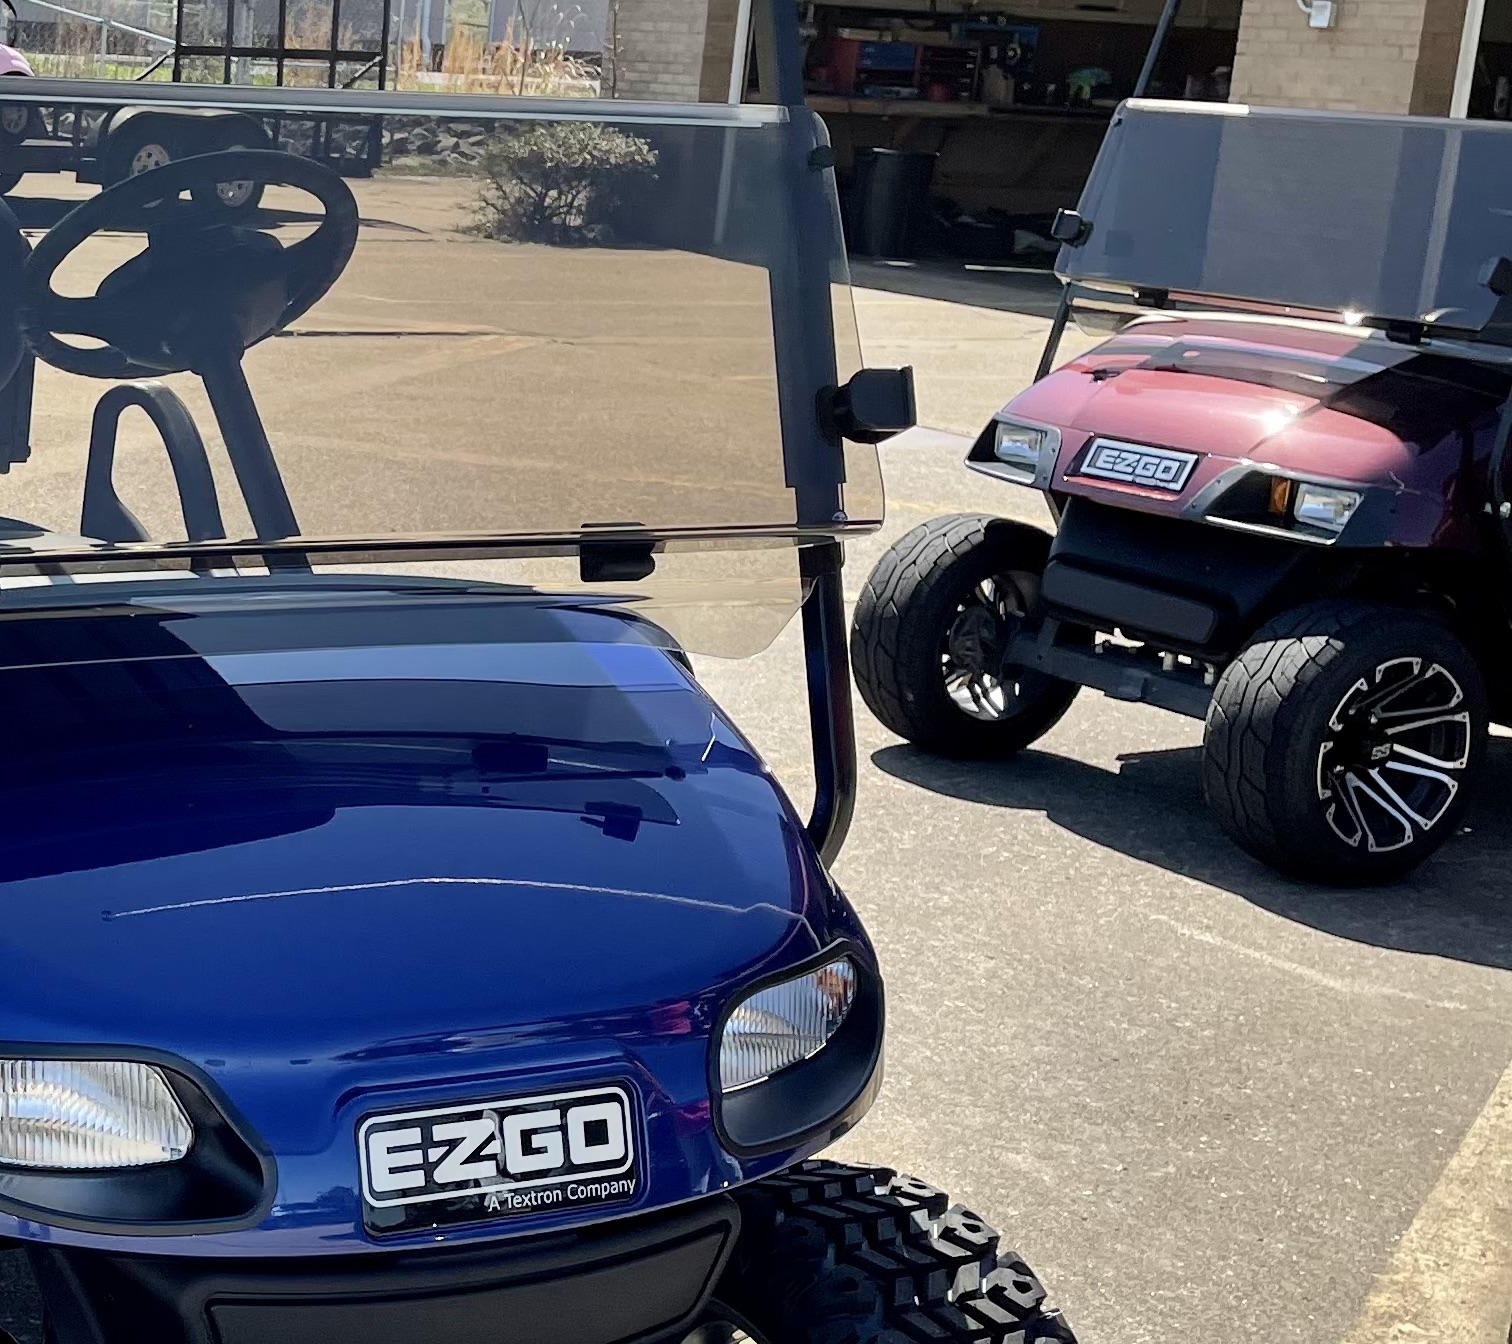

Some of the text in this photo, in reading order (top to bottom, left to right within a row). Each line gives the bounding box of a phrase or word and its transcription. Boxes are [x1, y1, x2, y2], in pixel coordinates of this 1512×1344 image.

[1095, 449, 1180, 481] EZGO
[368, 1101, 626, 1193] EZGO
[488, 1178, 636, 1212] A Textron Company
